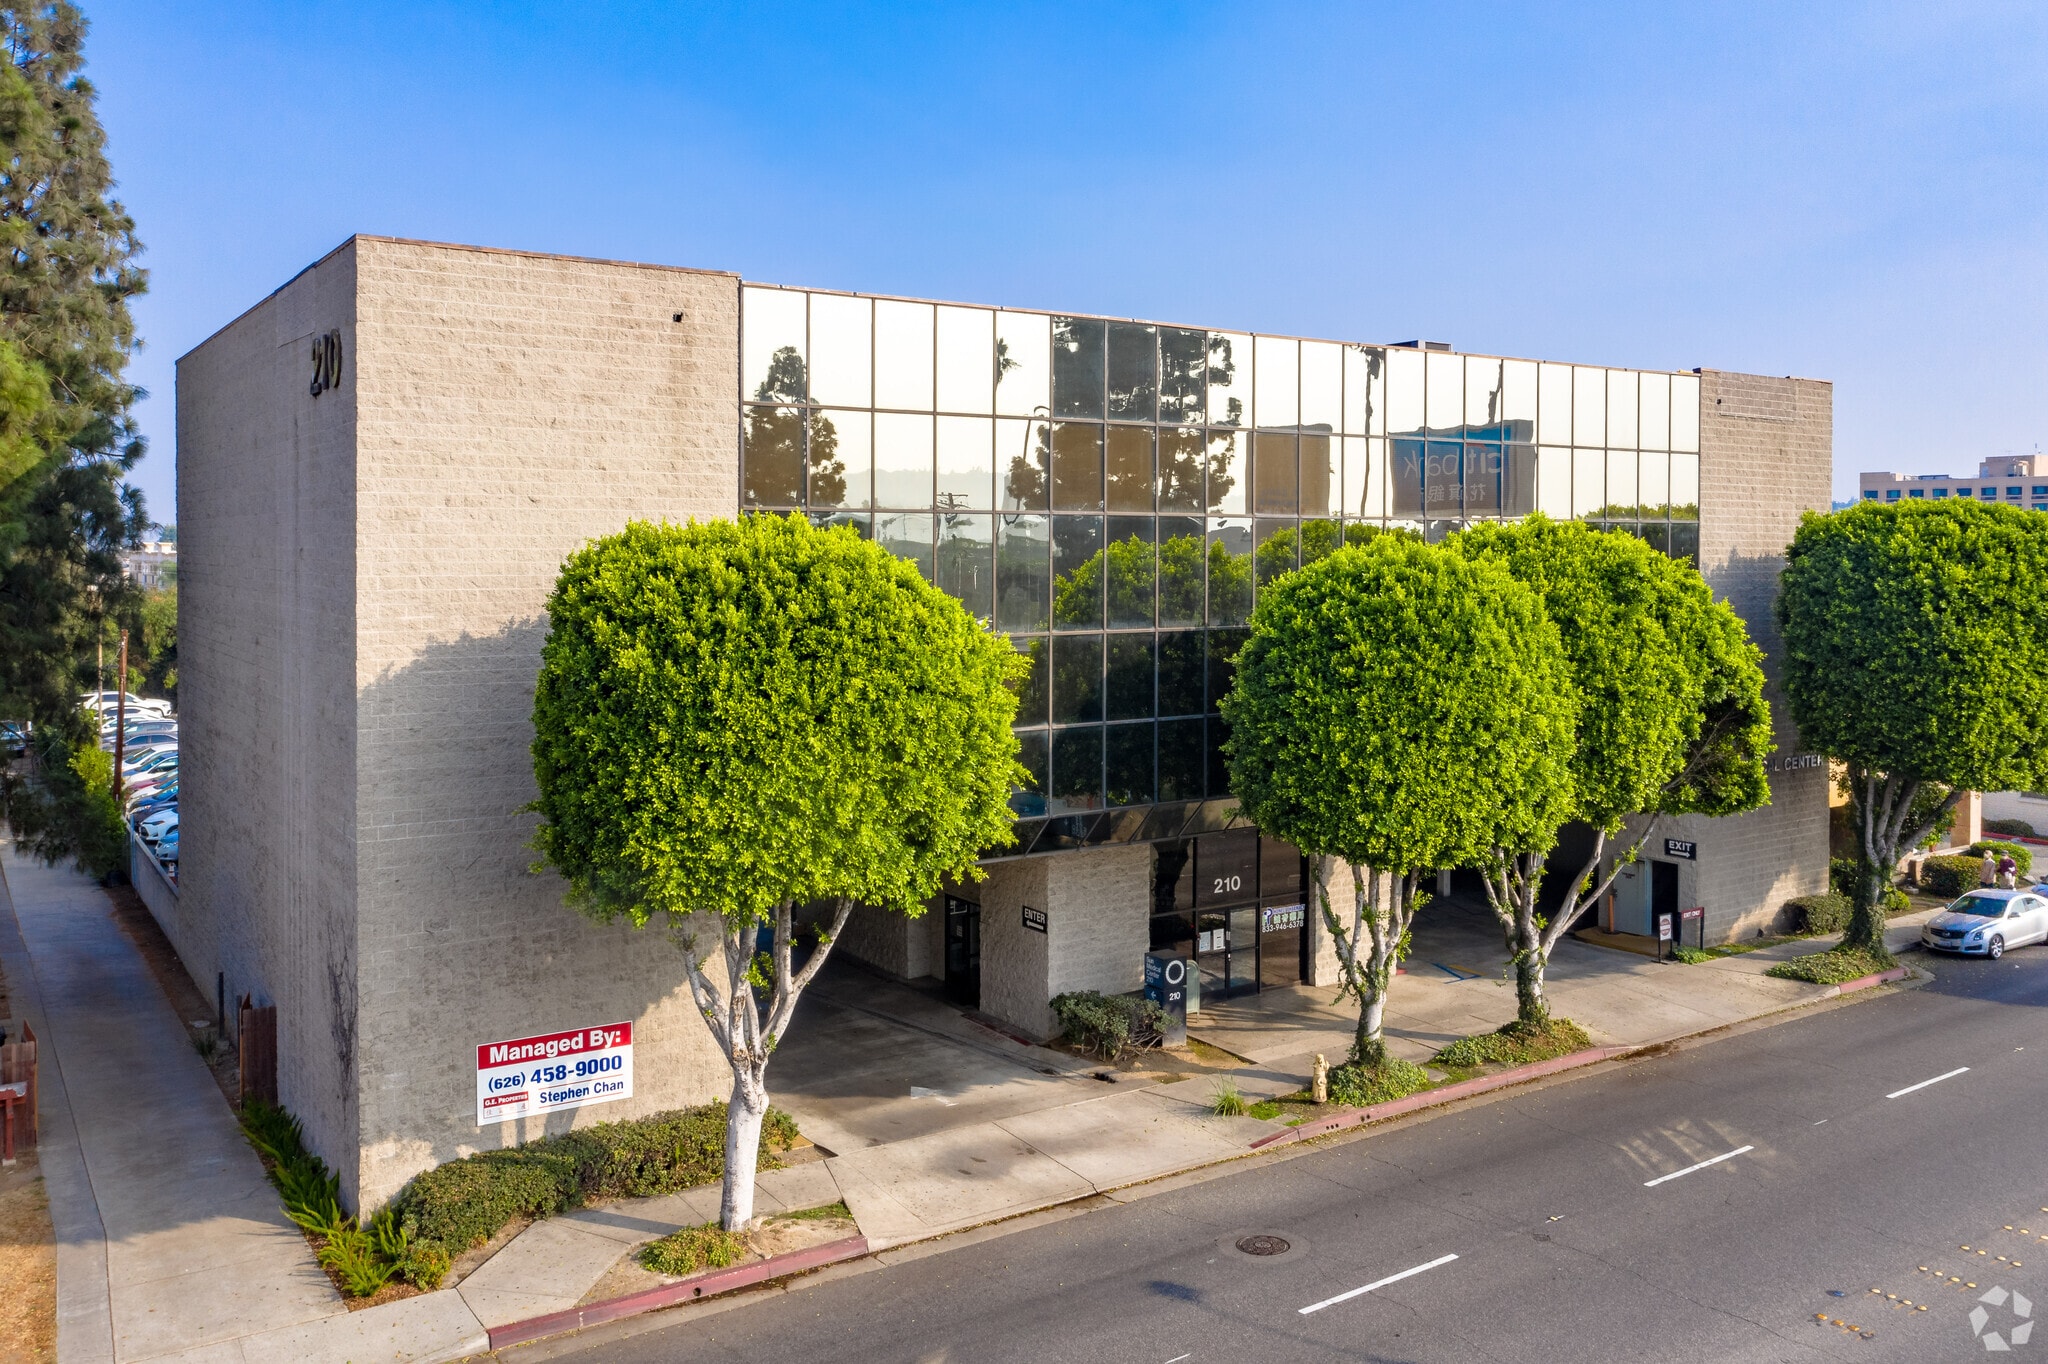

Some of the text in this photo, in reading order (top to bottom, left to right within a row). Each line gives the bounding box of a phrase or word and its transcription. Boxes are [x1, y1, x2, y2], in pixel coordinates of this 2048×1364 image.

[310, 329, 342, 398] 210
[1668, 840, 1692, 852] EXIT
[1213, 875, 1241, 893] 210
[1024, 908, 1046, 924] ENTER
[1262, 920, 1304, 933] 833-946-6378
[1169, 991, 1181, 1000] 210
[489, 1029, 621, 1064] Managed By:
[488, 1055, 622, 1093] (626) 458-9000
[539, 1081, 624, 1103] Stephen Chan
